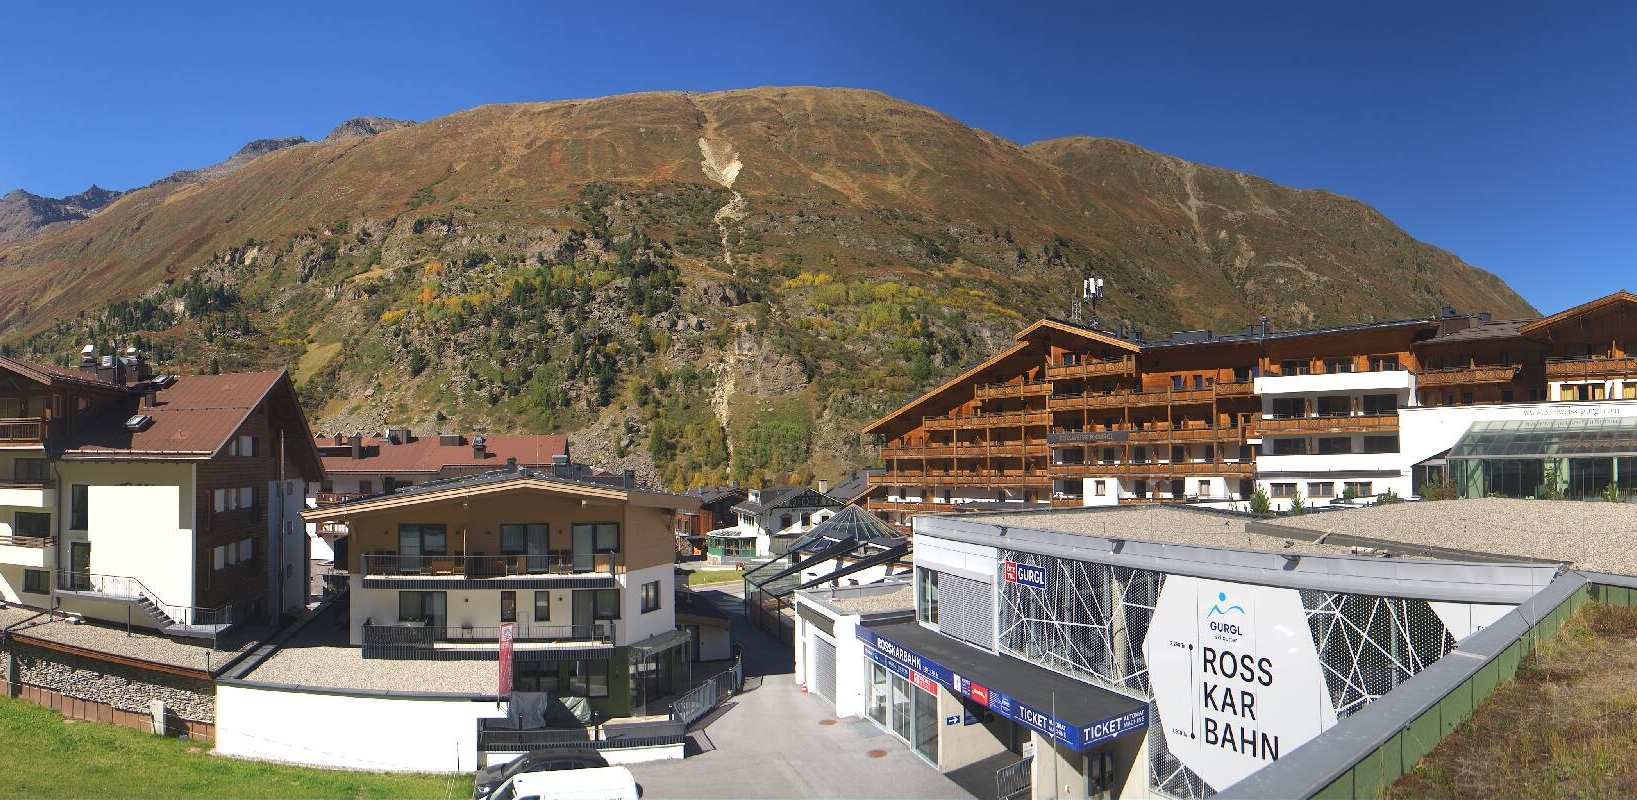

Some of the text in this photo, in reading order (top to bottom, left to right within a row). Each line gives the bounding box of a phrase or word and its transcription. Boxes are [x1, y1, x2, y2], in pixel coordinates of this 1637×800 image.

[1018, 567, 1045, 585] GURGL
[1210, 621, 1243, 636] GURGL
[877, 637, 922, 670] ROSSKARBAHN
[1203, 646, 1273, 687] ROSS
[1203, 681, 1256, 720] KAR
[1019, 705, 1047, 729] TICKET
[1084, 717, 1122, 741] TICKET
[1204, 717, 1279, 762] BAHN
